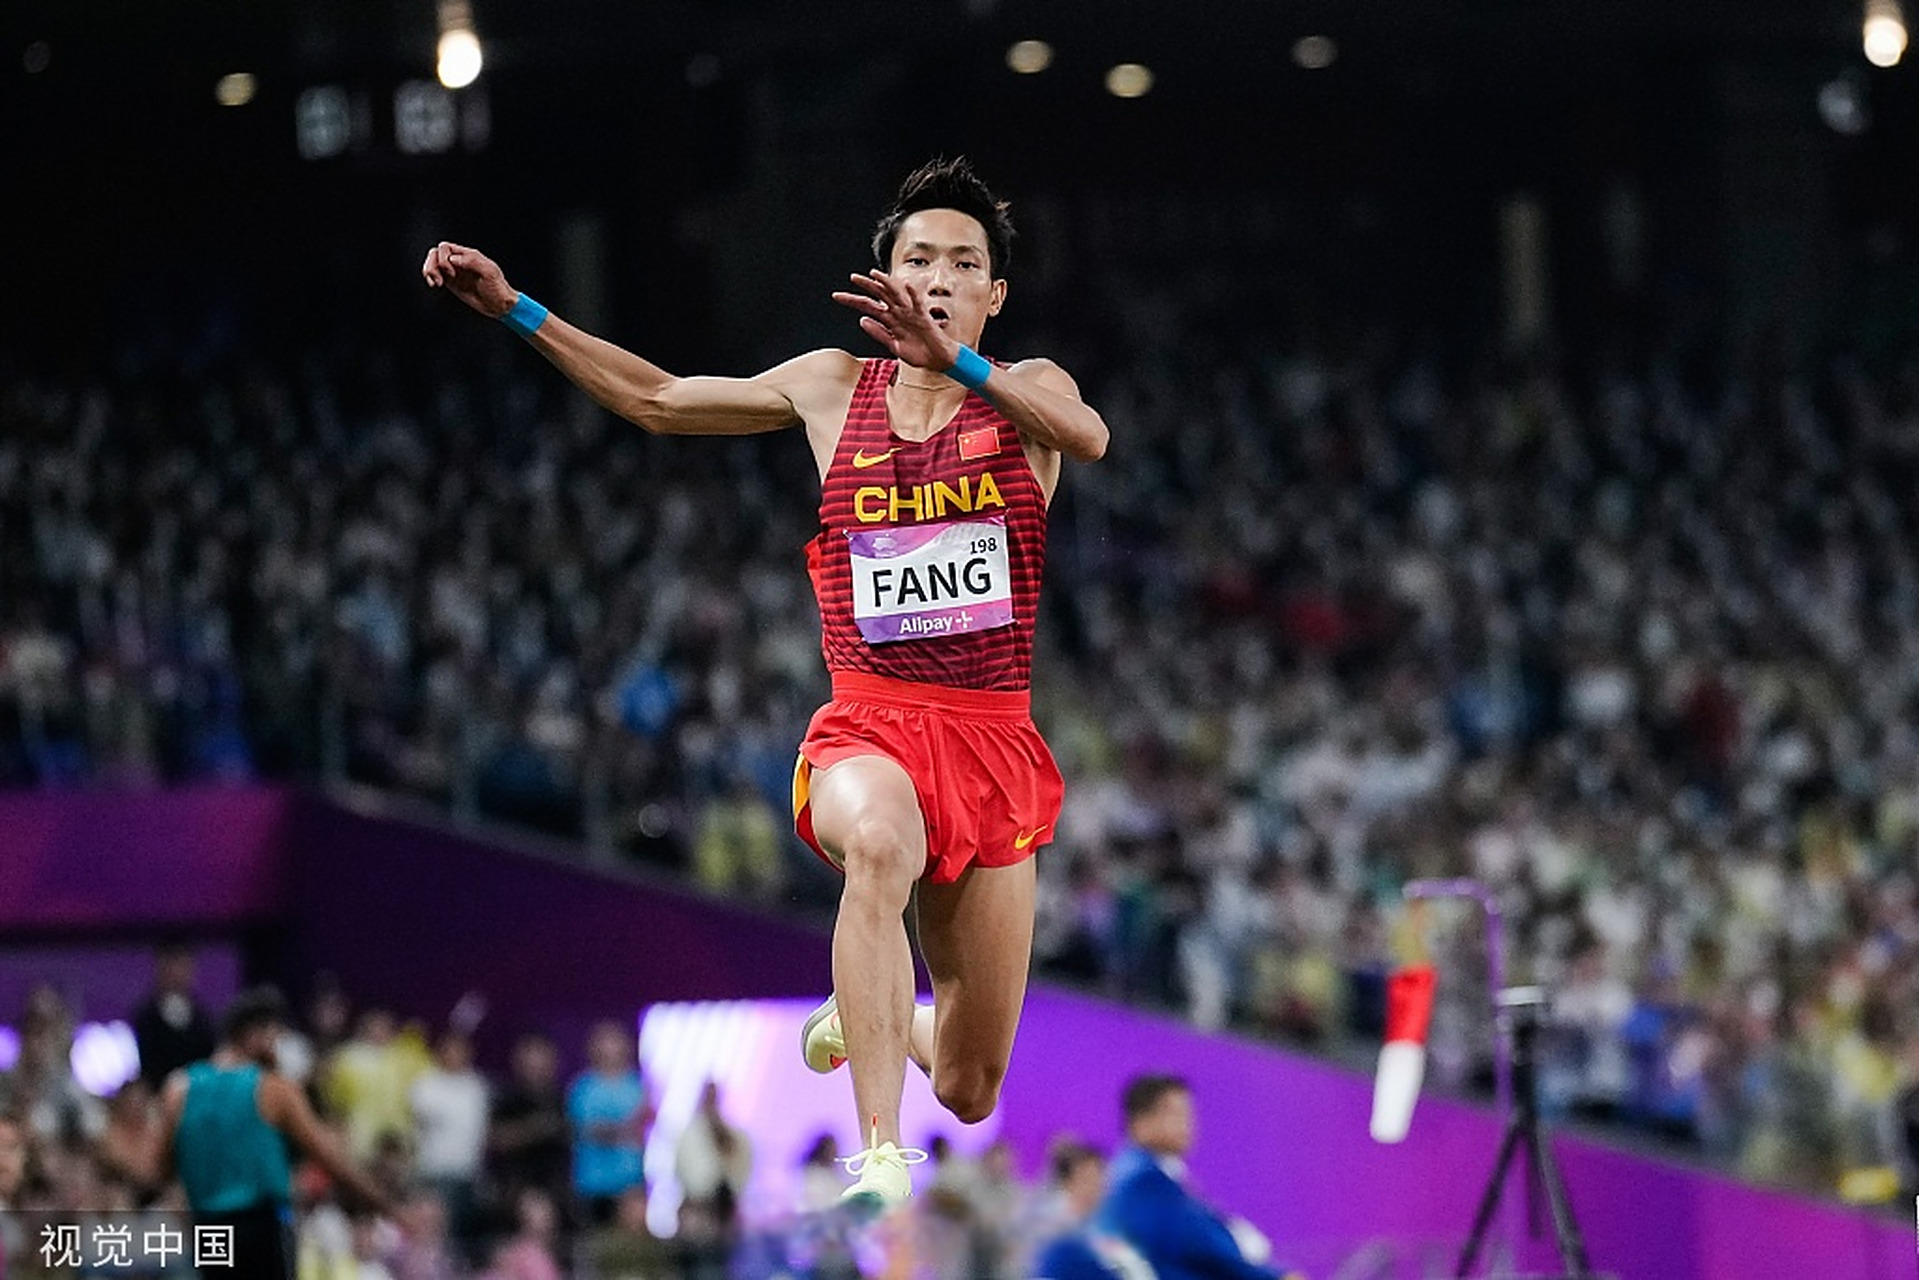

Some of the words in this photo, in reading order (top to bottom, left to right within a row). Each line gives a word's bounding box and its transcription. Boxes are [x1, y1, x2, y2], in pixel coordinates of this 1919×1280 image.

[853, 471, 1006, 523] CHINA
[969, 537, 998, 555] 198
[872, 557, 992, 608] FANG
